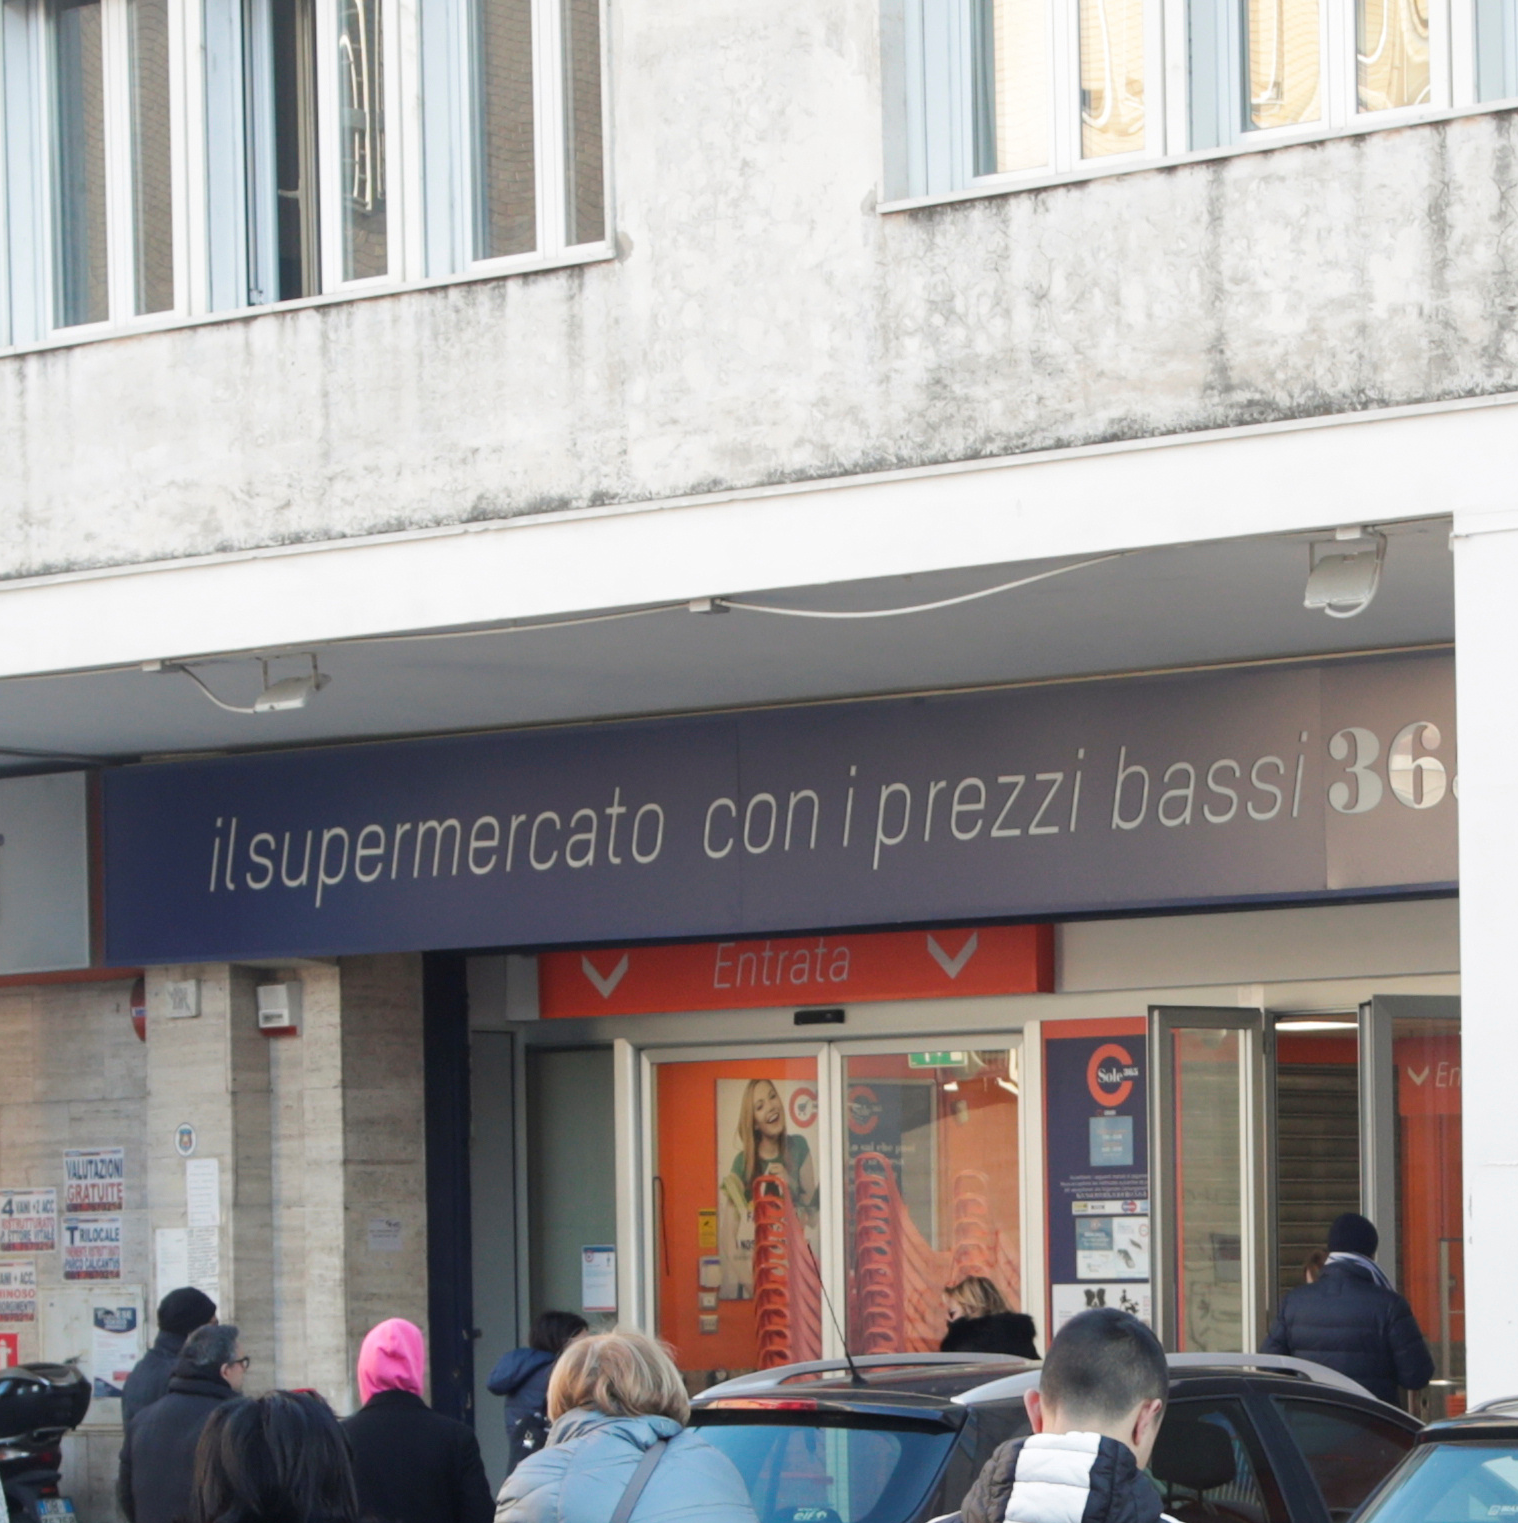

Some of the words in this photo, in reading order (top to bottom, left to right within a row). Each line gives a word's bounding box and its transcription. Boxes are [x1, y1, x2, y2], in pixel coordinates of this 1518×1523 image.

[702, 787, 819, 860] con
[842, 765, 857, 848] i
[871, 748, 1085, 871] prezzi
[1110, 731, 1309, 830] bassi
[1327, 720, 1459, 815] 36
[713, 938, 851, 989] Entrata
[1097, 1067, 1123, 1084] Sole
[65, 1157, 123, 1180] VALUTAZIONI
[67, 1182, 123, 1203] GRATUITE
[1, 1197, 14, 1218] 4
